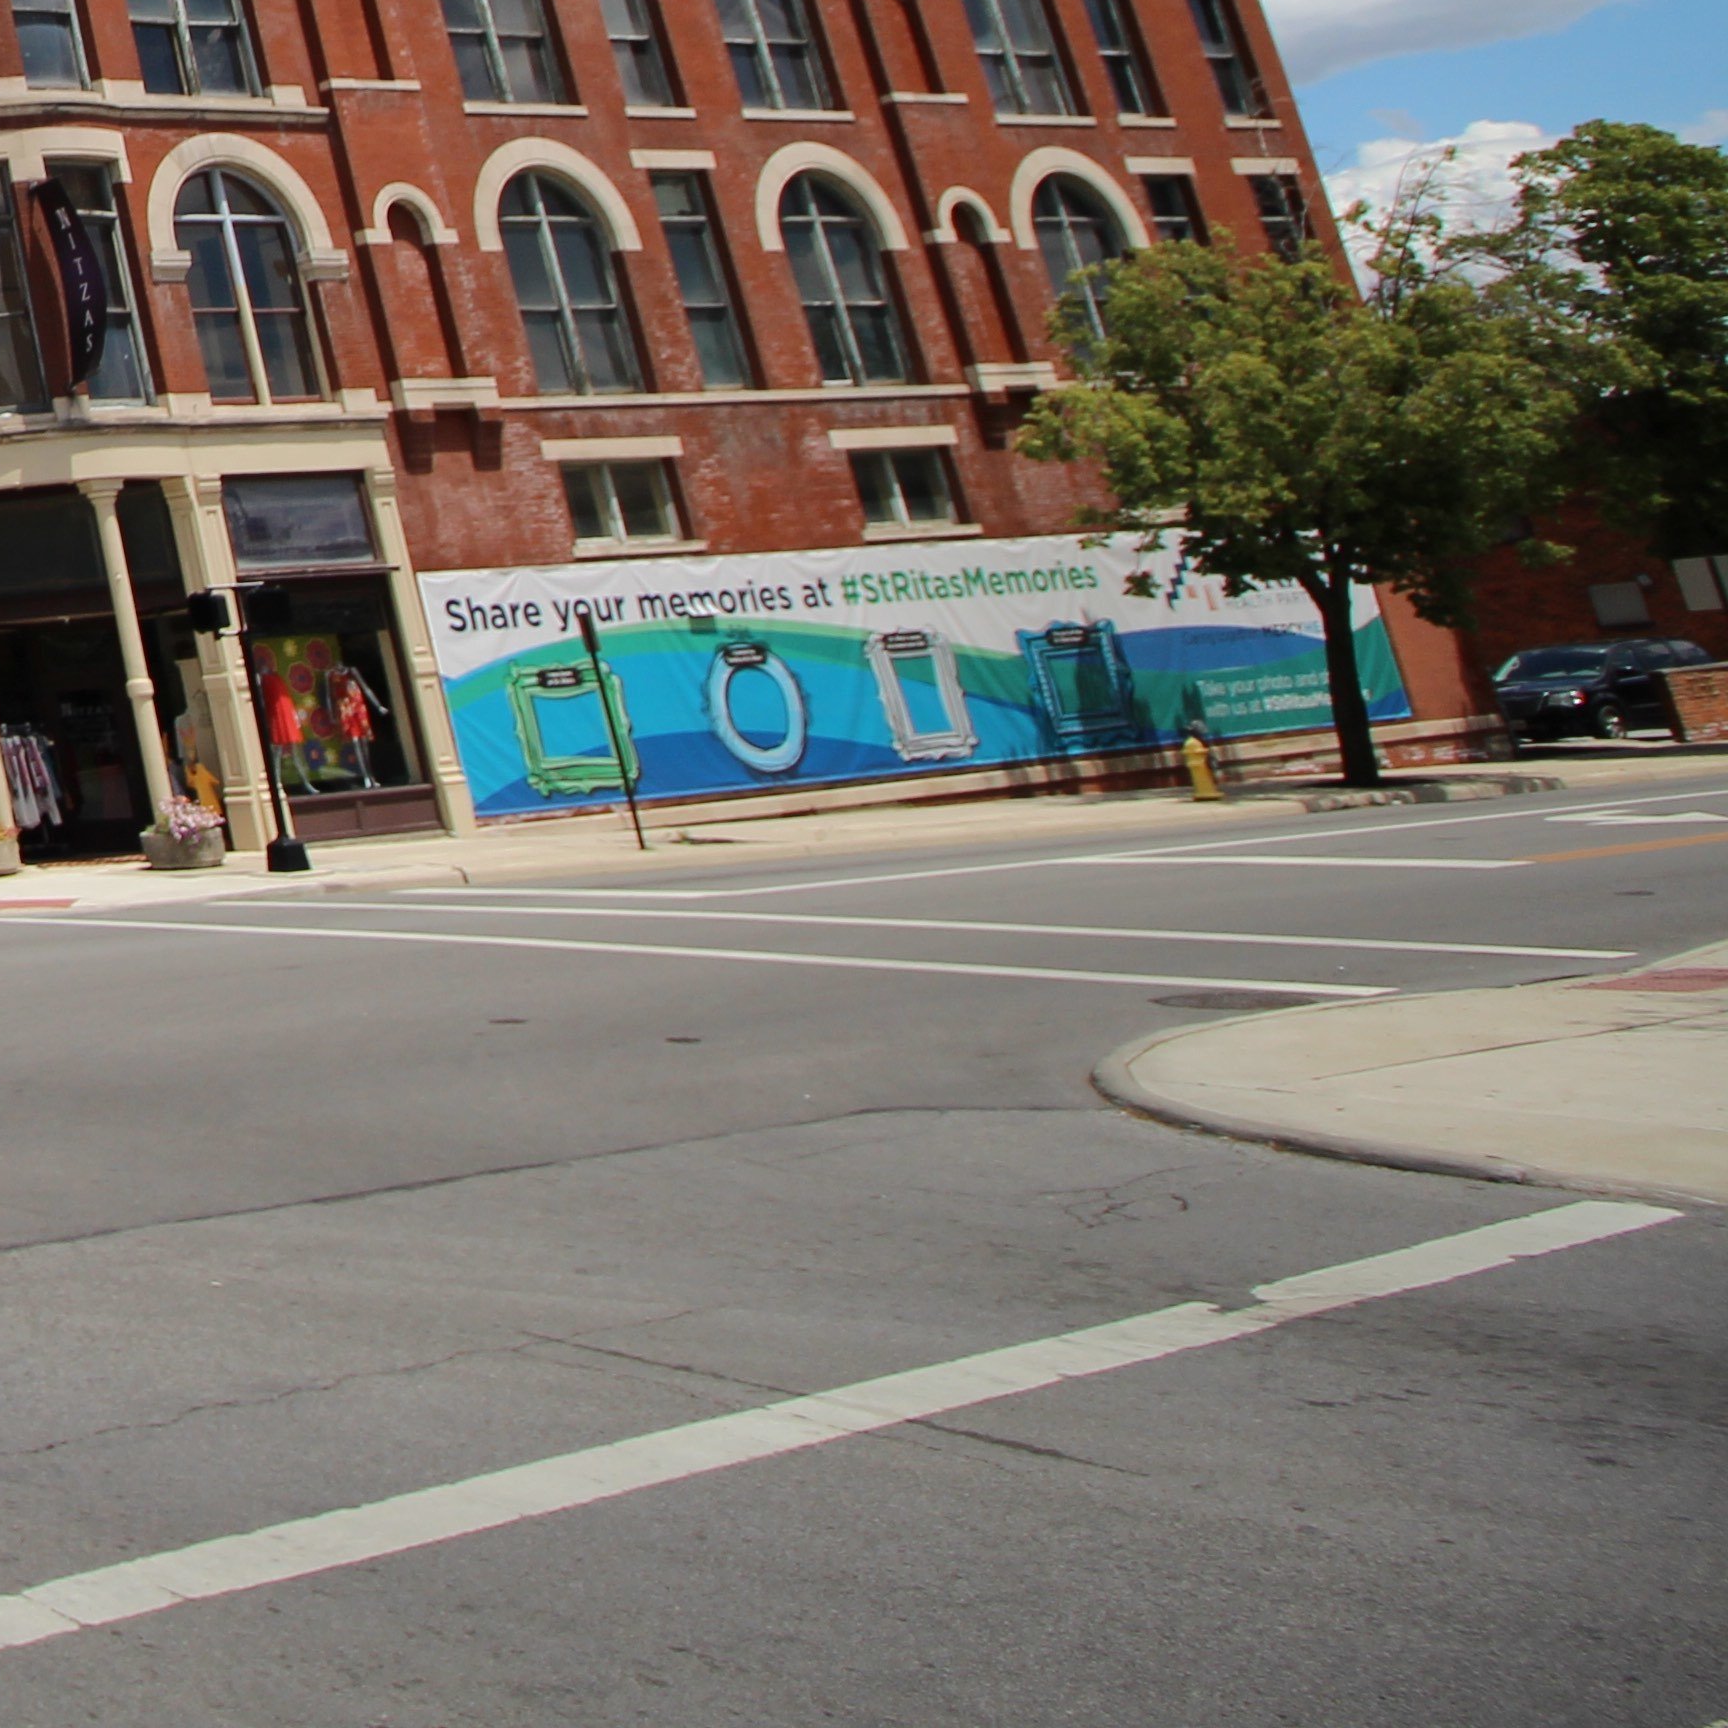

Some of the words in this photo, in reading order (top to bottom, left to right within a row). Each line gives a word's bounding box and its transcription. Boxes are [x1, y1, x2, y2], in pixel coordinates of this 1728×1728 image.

[445, 596, 541, 633] Share
[552, 593, 625, 632] your
[637, 579, 792, 619] memories
[802, 577, 833, 609] at
[840, 560, 1099, 606] #StRitasMemories
